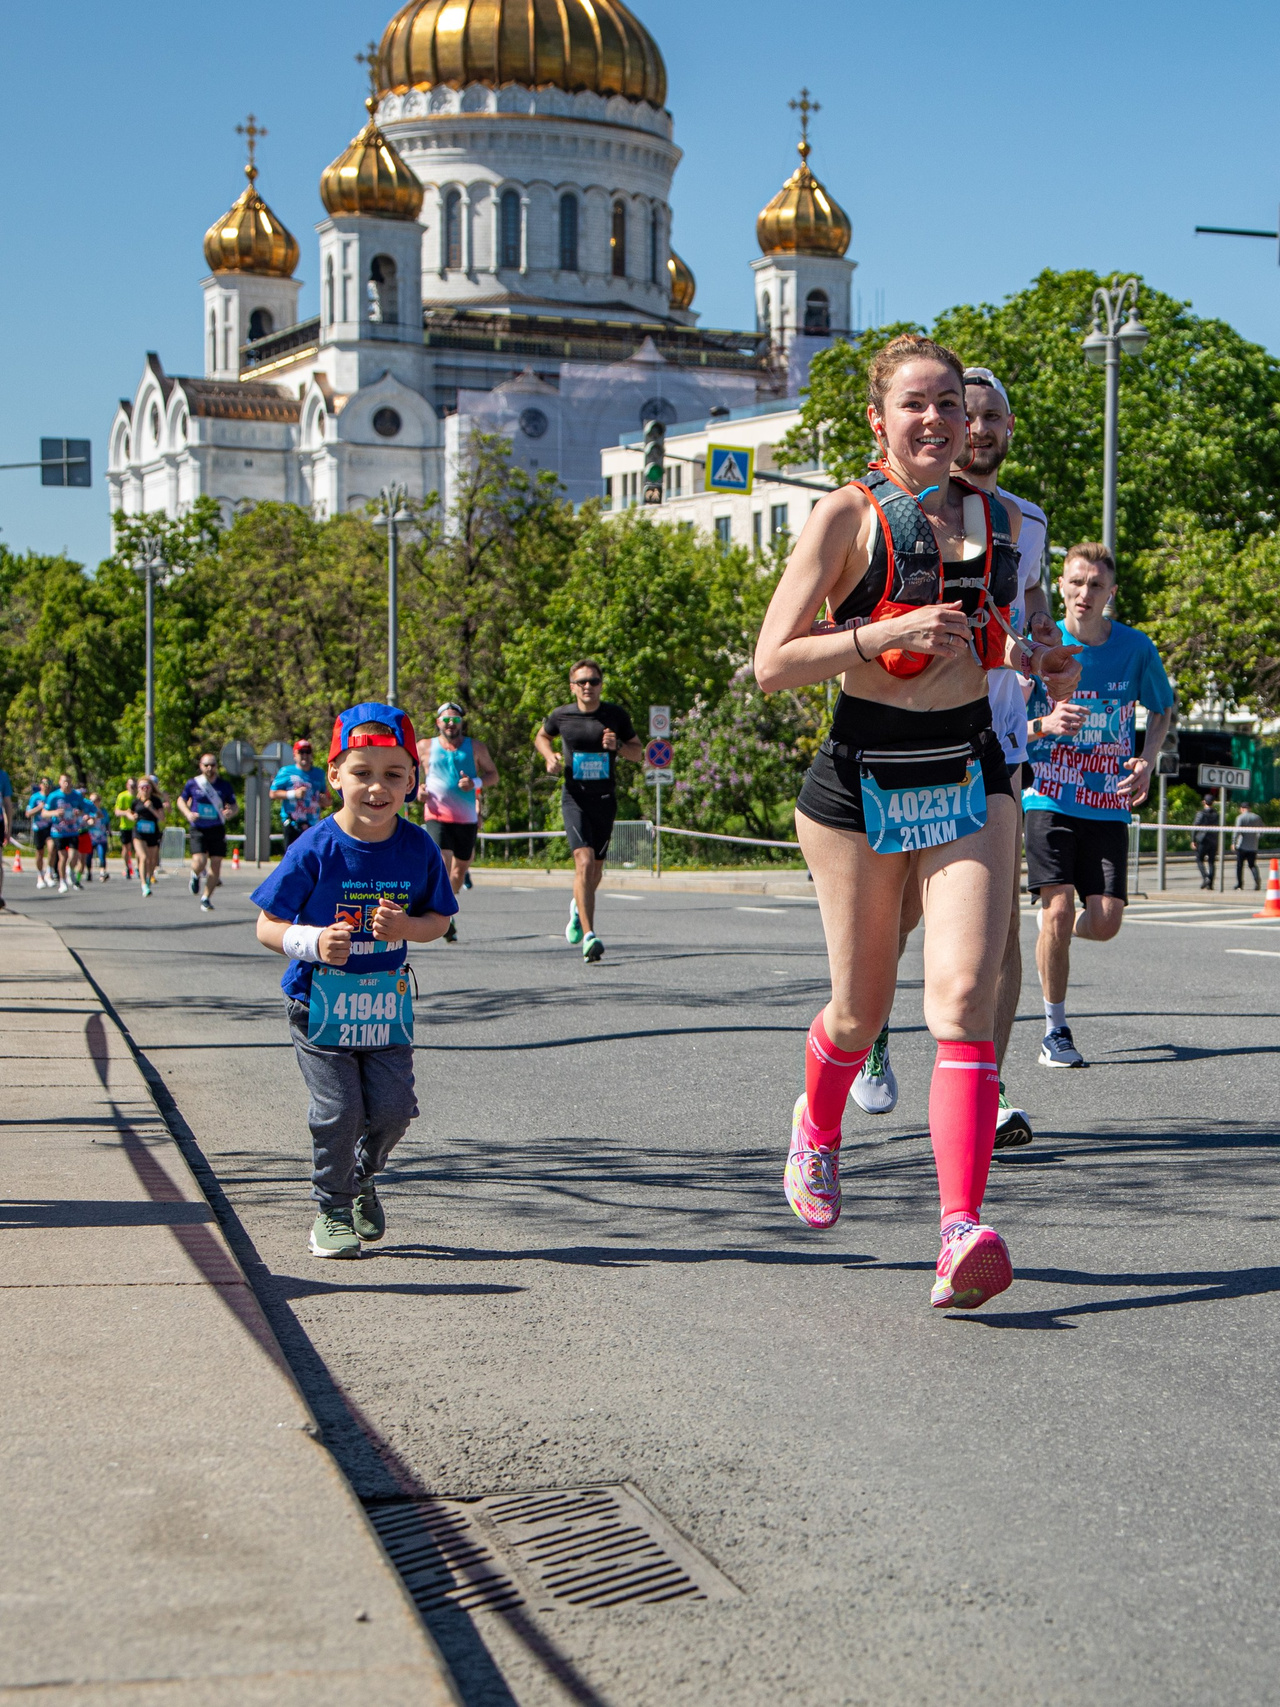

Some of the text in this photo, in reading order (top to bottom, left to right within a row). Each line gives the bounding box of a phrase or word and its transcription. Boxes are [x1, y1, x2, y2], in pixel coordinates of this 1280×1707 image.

[1207, 768, 1245, 785] СТОП
[887, 786, 962, 823] 40237
[900, 820, 958, 851] 21.1KM
[342, 879, 411, 891] when i grow up
[344, 891, 348, 900] i
[349, 892, 381, 900] wanna
[383, 891, 395, 900] be
[399, 981, 405, 992] B
[333, 992, 397, 1021] 41948
[338, 1023, 391, 1047] 21.1KM
